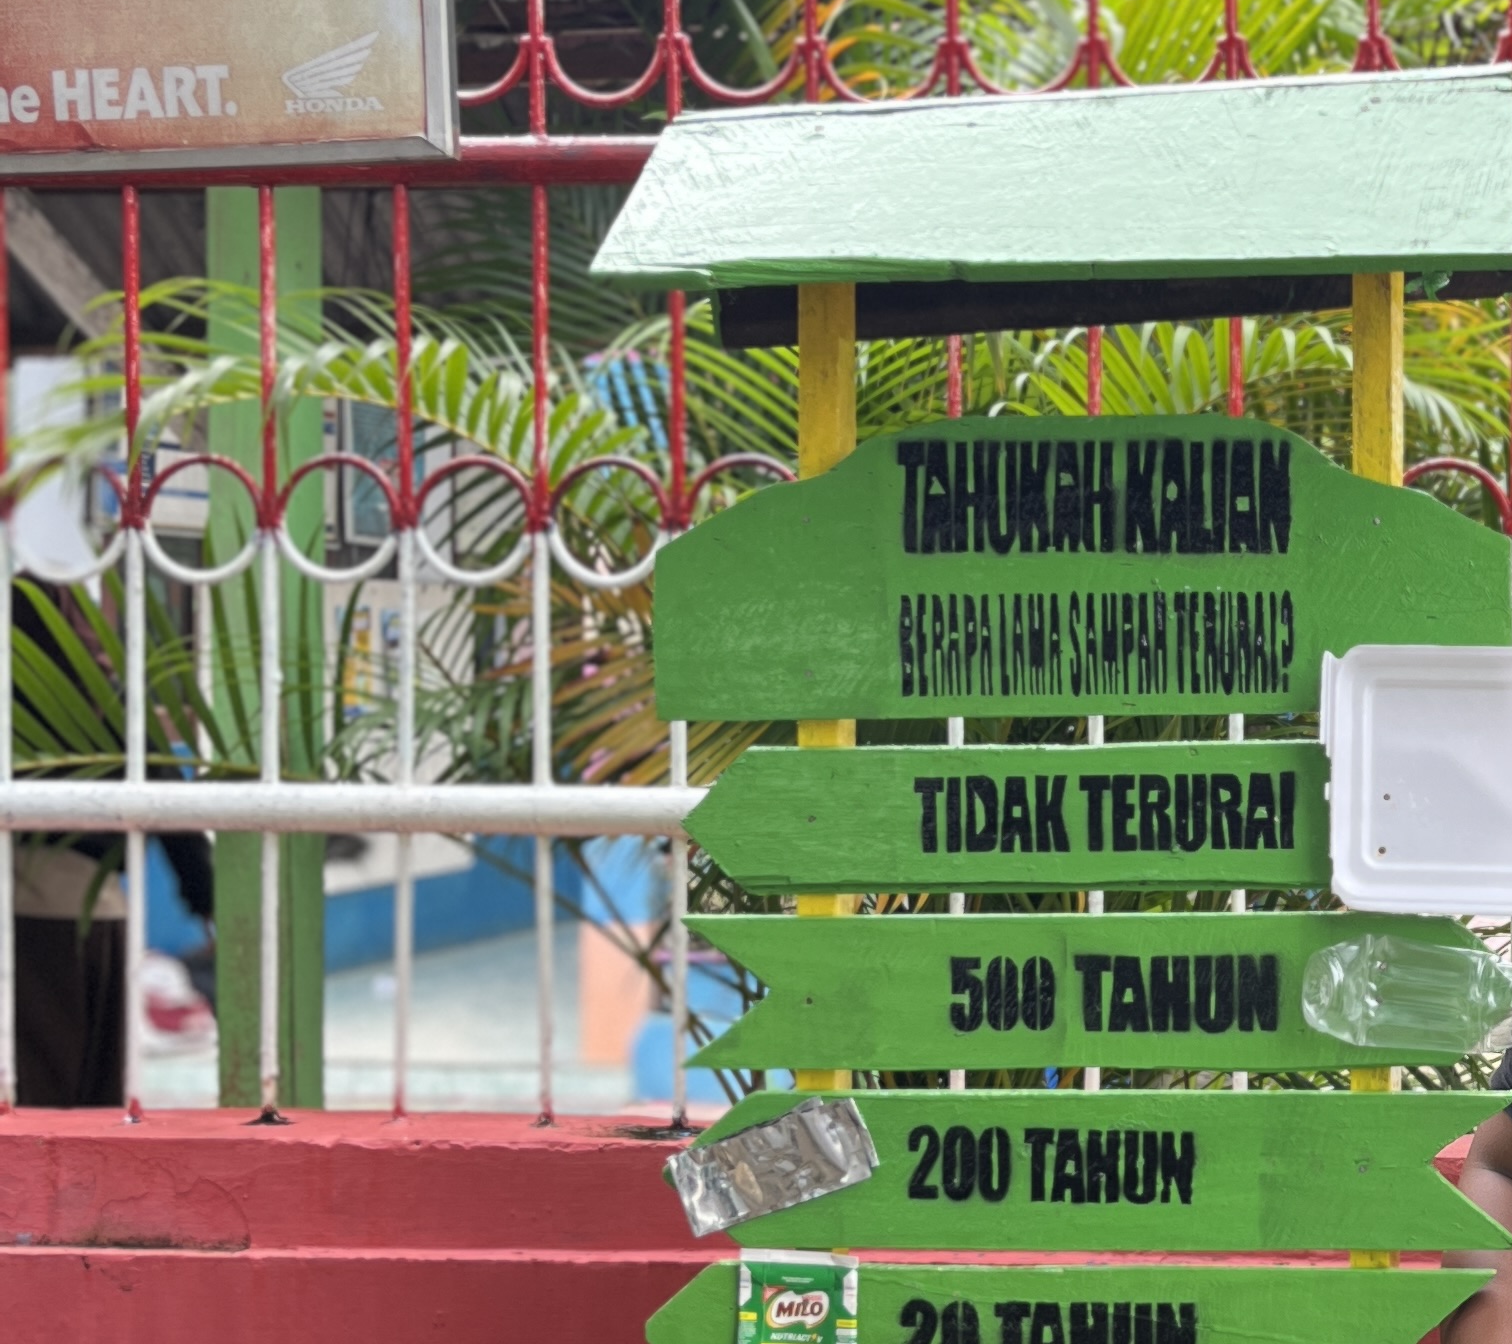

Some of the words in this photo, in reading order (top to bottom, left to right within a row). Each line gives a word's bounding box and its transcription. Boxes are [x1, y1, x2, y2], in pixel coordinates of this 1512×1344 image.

[52, 64, 239, 122] HEART.
[285, 96, 385, 115] HONDA
[898, 439, 1114, 554] TAHUKAH
[1125, 439, 1292, 554] KALIAN
[900, 593, 994, 697] BERAPA
[999, 592, 1063, 697] LAMA
[1069, 590, 1168, 697] SAMPAH
[914, 774, 1071, 853] TIDAK
[1079, 771, 1296, 852] TERURAI
[949, 954, 1056, 1032] 500
[1074, 954, 1281, 1033] TAHUN
[907, 1124, 1011, 1202] 200
[1024, 1127, 1195, 1205] TAHUN
[776, 1297, 824, 1318] MILO
